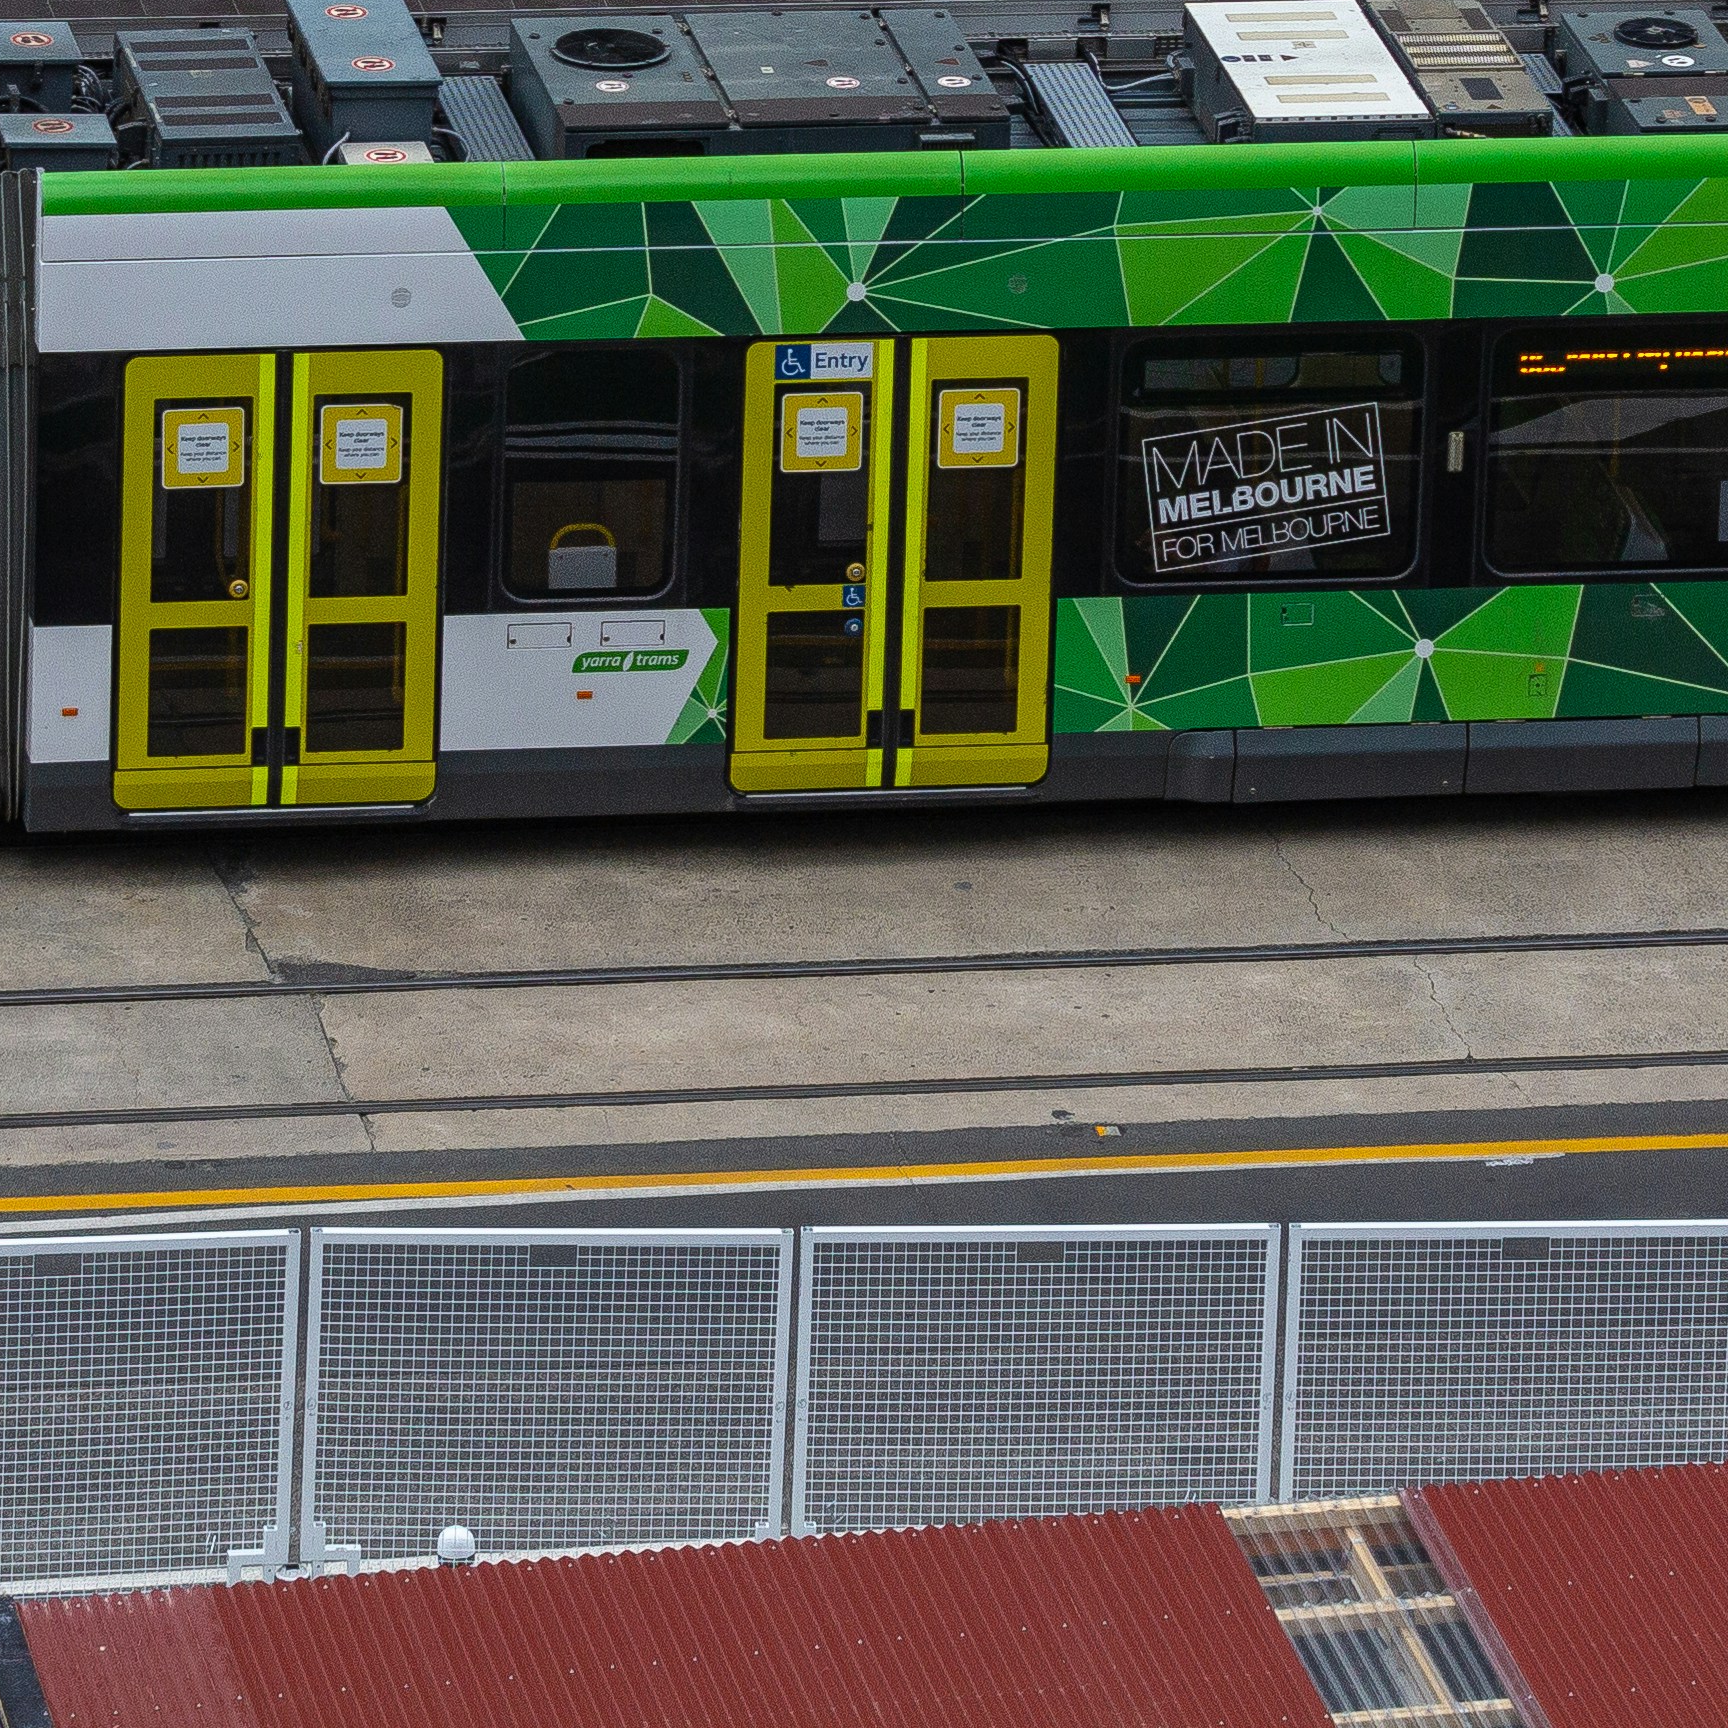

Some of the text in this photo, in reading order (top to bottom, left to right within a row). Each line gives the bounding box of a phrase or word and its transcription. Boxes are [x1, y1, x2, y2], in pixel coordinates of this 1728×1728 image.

[814, 352, 869, 372] Entry
[1152, 412, 1374, 493] MADE IN
[1157, 464, 1377, 524] MELBOURNE
[1162, 506, 1381, 562] FOR MELBOURNE
[581, 654, 680, 670] yarra trams
